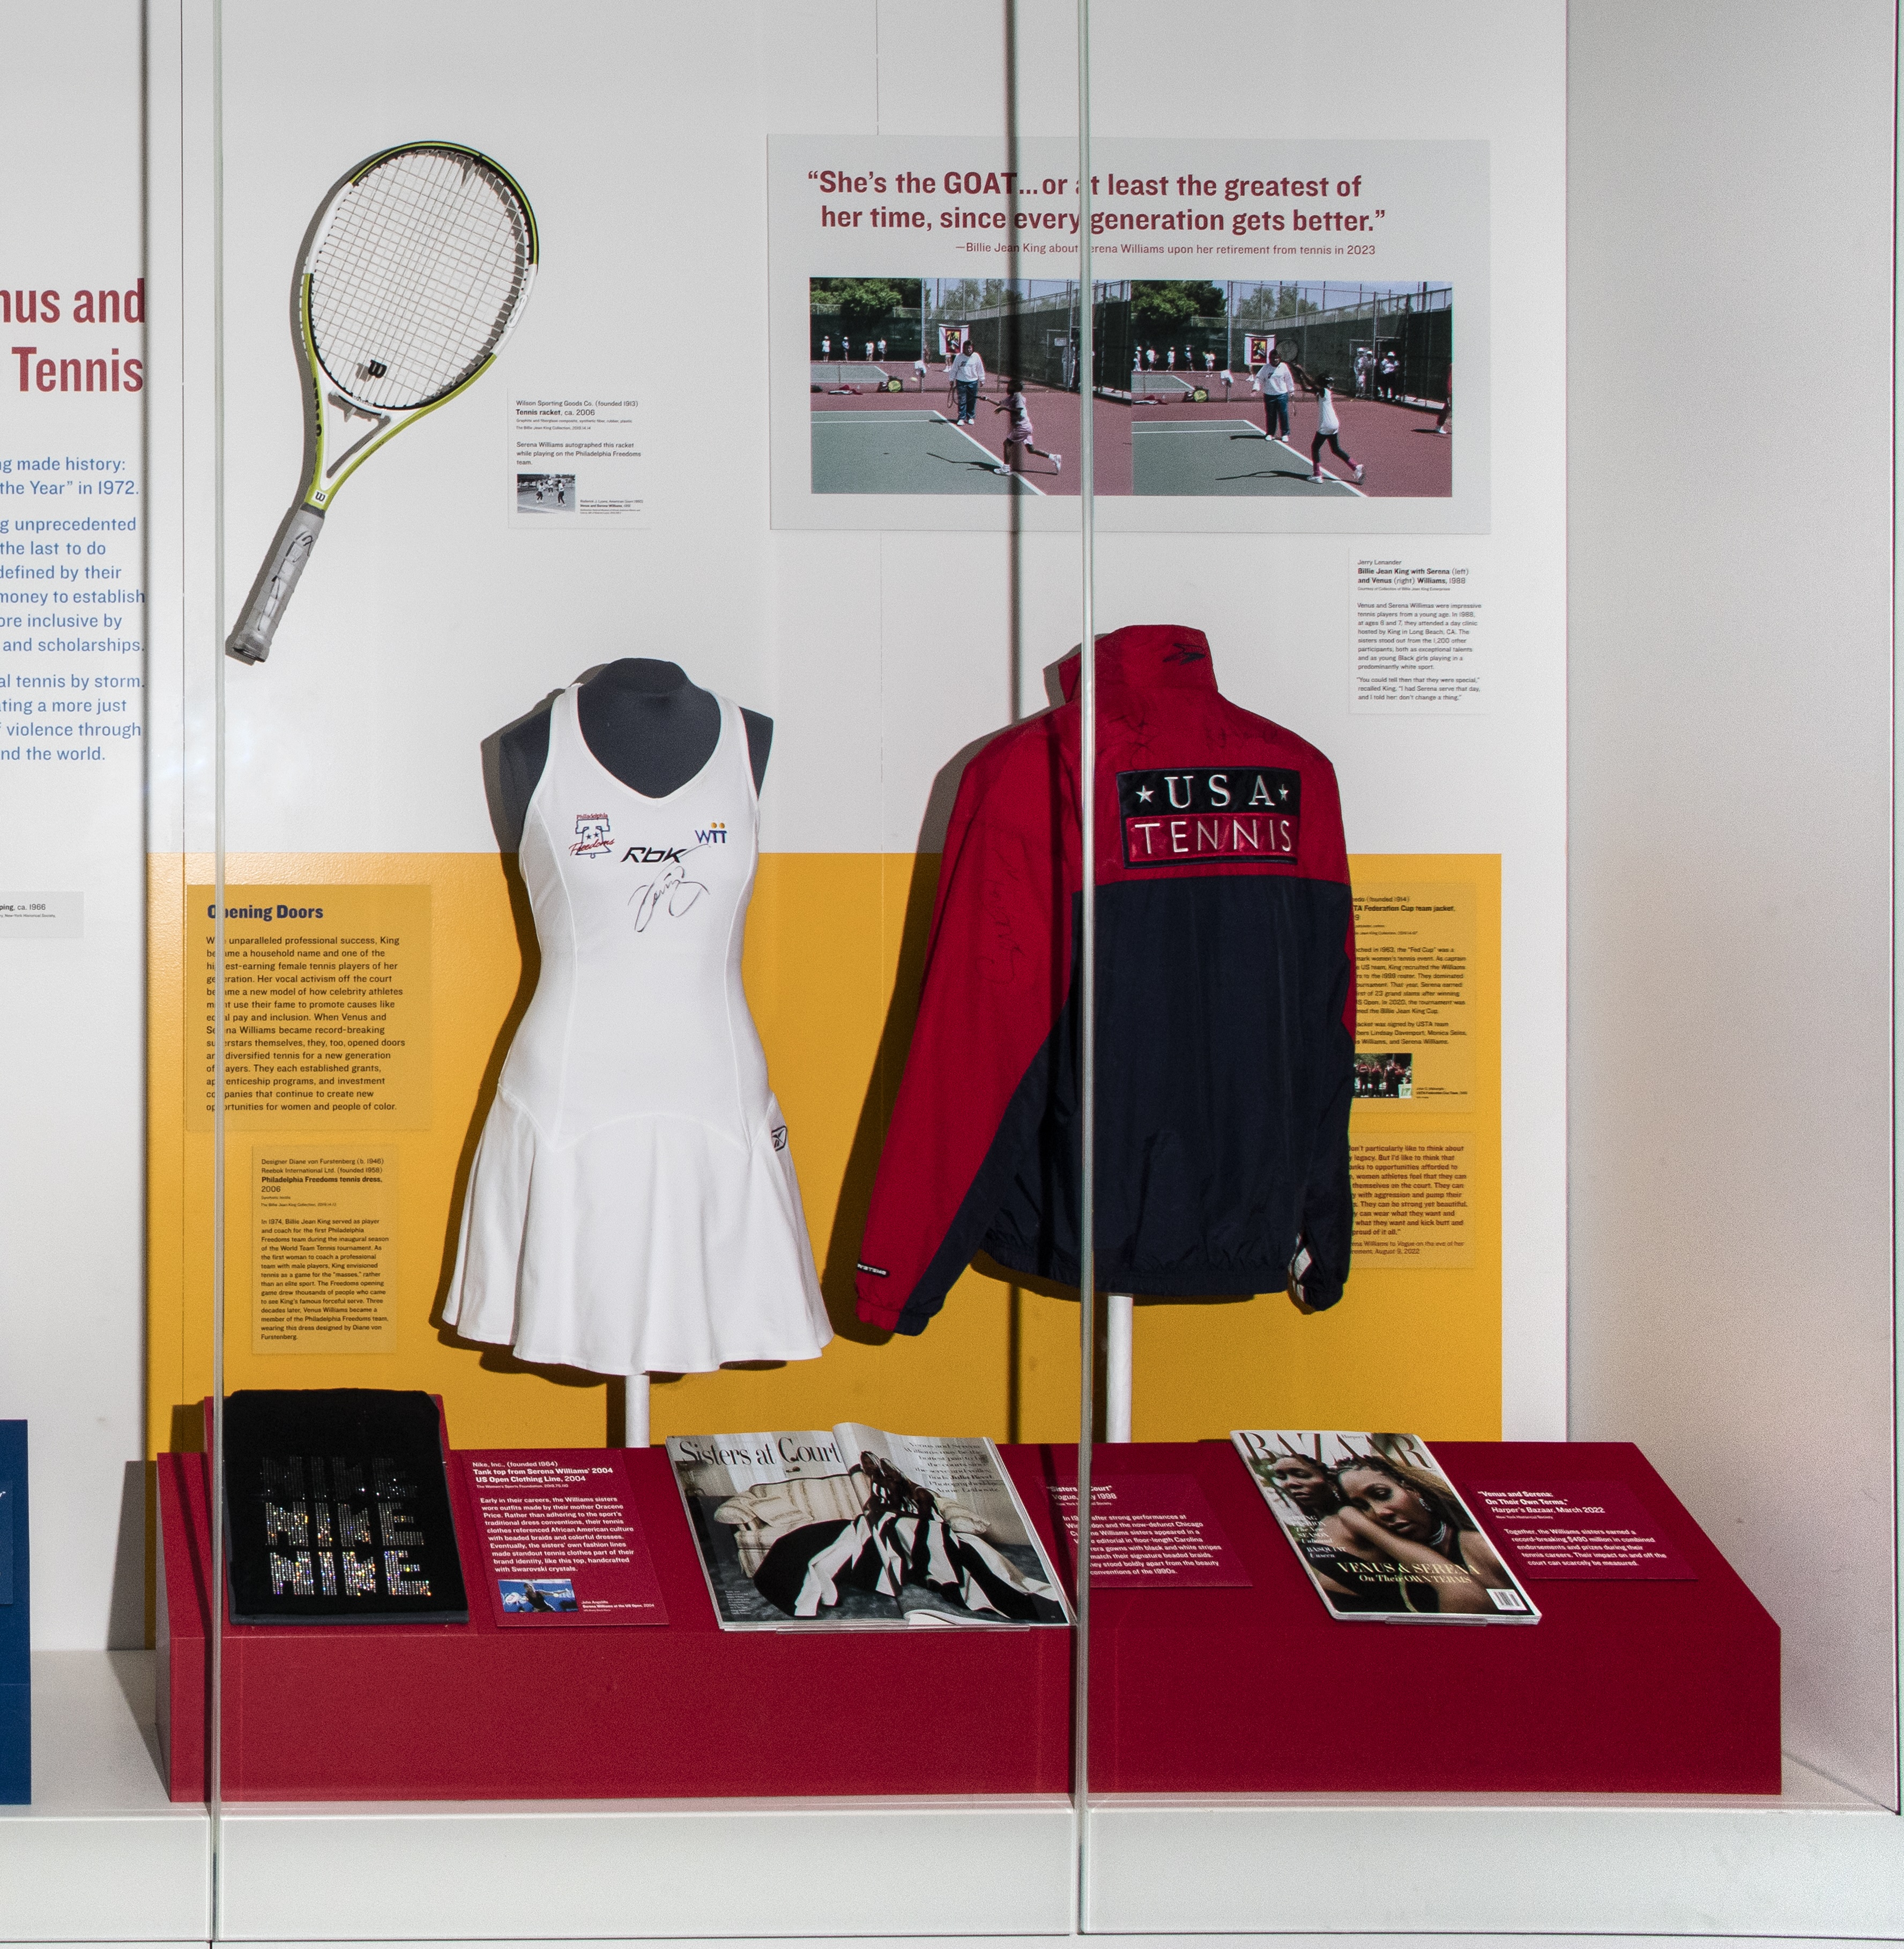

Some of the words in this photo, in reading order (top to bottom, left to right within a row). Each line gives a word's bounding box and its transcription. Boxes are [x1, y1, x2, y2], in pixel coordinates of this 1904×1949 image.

[896, 172, 935, 194] the
[1043, 178, 1068, 195] or
[1109, 174, 1169, 195] least
[1177, 174, 1216, 196] the
[1225, 177, 1329, 201] greatest
[1337, 175, 1362, 197] of
[822, 205, 862, 227] her
[870, 206, 931, 230] time,
[940, 207, 1006, 229] since
[1015, 213, 1079, 234] every
[1091, 209, 1224, 234] generation
[1232, 212, 1284, 235] gets
[994, 243, 1020, 253] Jean
[1023, 243, 1046, 254] King
[1049, 243, 1078, 252] about
[1121, 244, 1164, 253] Williams
[1168, 247, 1193, 255] upon
[1197, 244, 1213, 254] her
[1217, 246, 1269, 254] retirement
[1273, 245, 1296, 254] from
[1300, 246, 1332, 254] tennis
[1335, 246, 1343, 254] in
[1347, 245, 1375, 255] 2023
[73, 278, 145, 323] and
[11, 347, 143, 392] Tennis
[18, 457, 60, 470] made
[66, 457, 125, 473] history:
[79, 481, 92, 494] in
[99, 481, 139, 494] 1972.
[16, 517, 136, 533] unprecedented
[3, 638, 32, 651] and
[39, 637, 146, 656] scholarships.
[1135, 820, 1291, 854] TENNIS
[569, 838, 615, 856] Freedoms
[277, 905, 323, 918] Doors
[229, 936, 282, 946] unparalleled
[285, 936, 337, 946] professional
[381, 936, 399, 946] King
[679, 1440, 752, 1466] Sisters
[756, 1444, 775, 1465] at
[778, 1437, 842, 1463] Court
[511, 1476, 542, 1484] Clothing
[1337, 1562, 1395, 1573] VENUS
[1399, 1563, 1410, 1573] &
